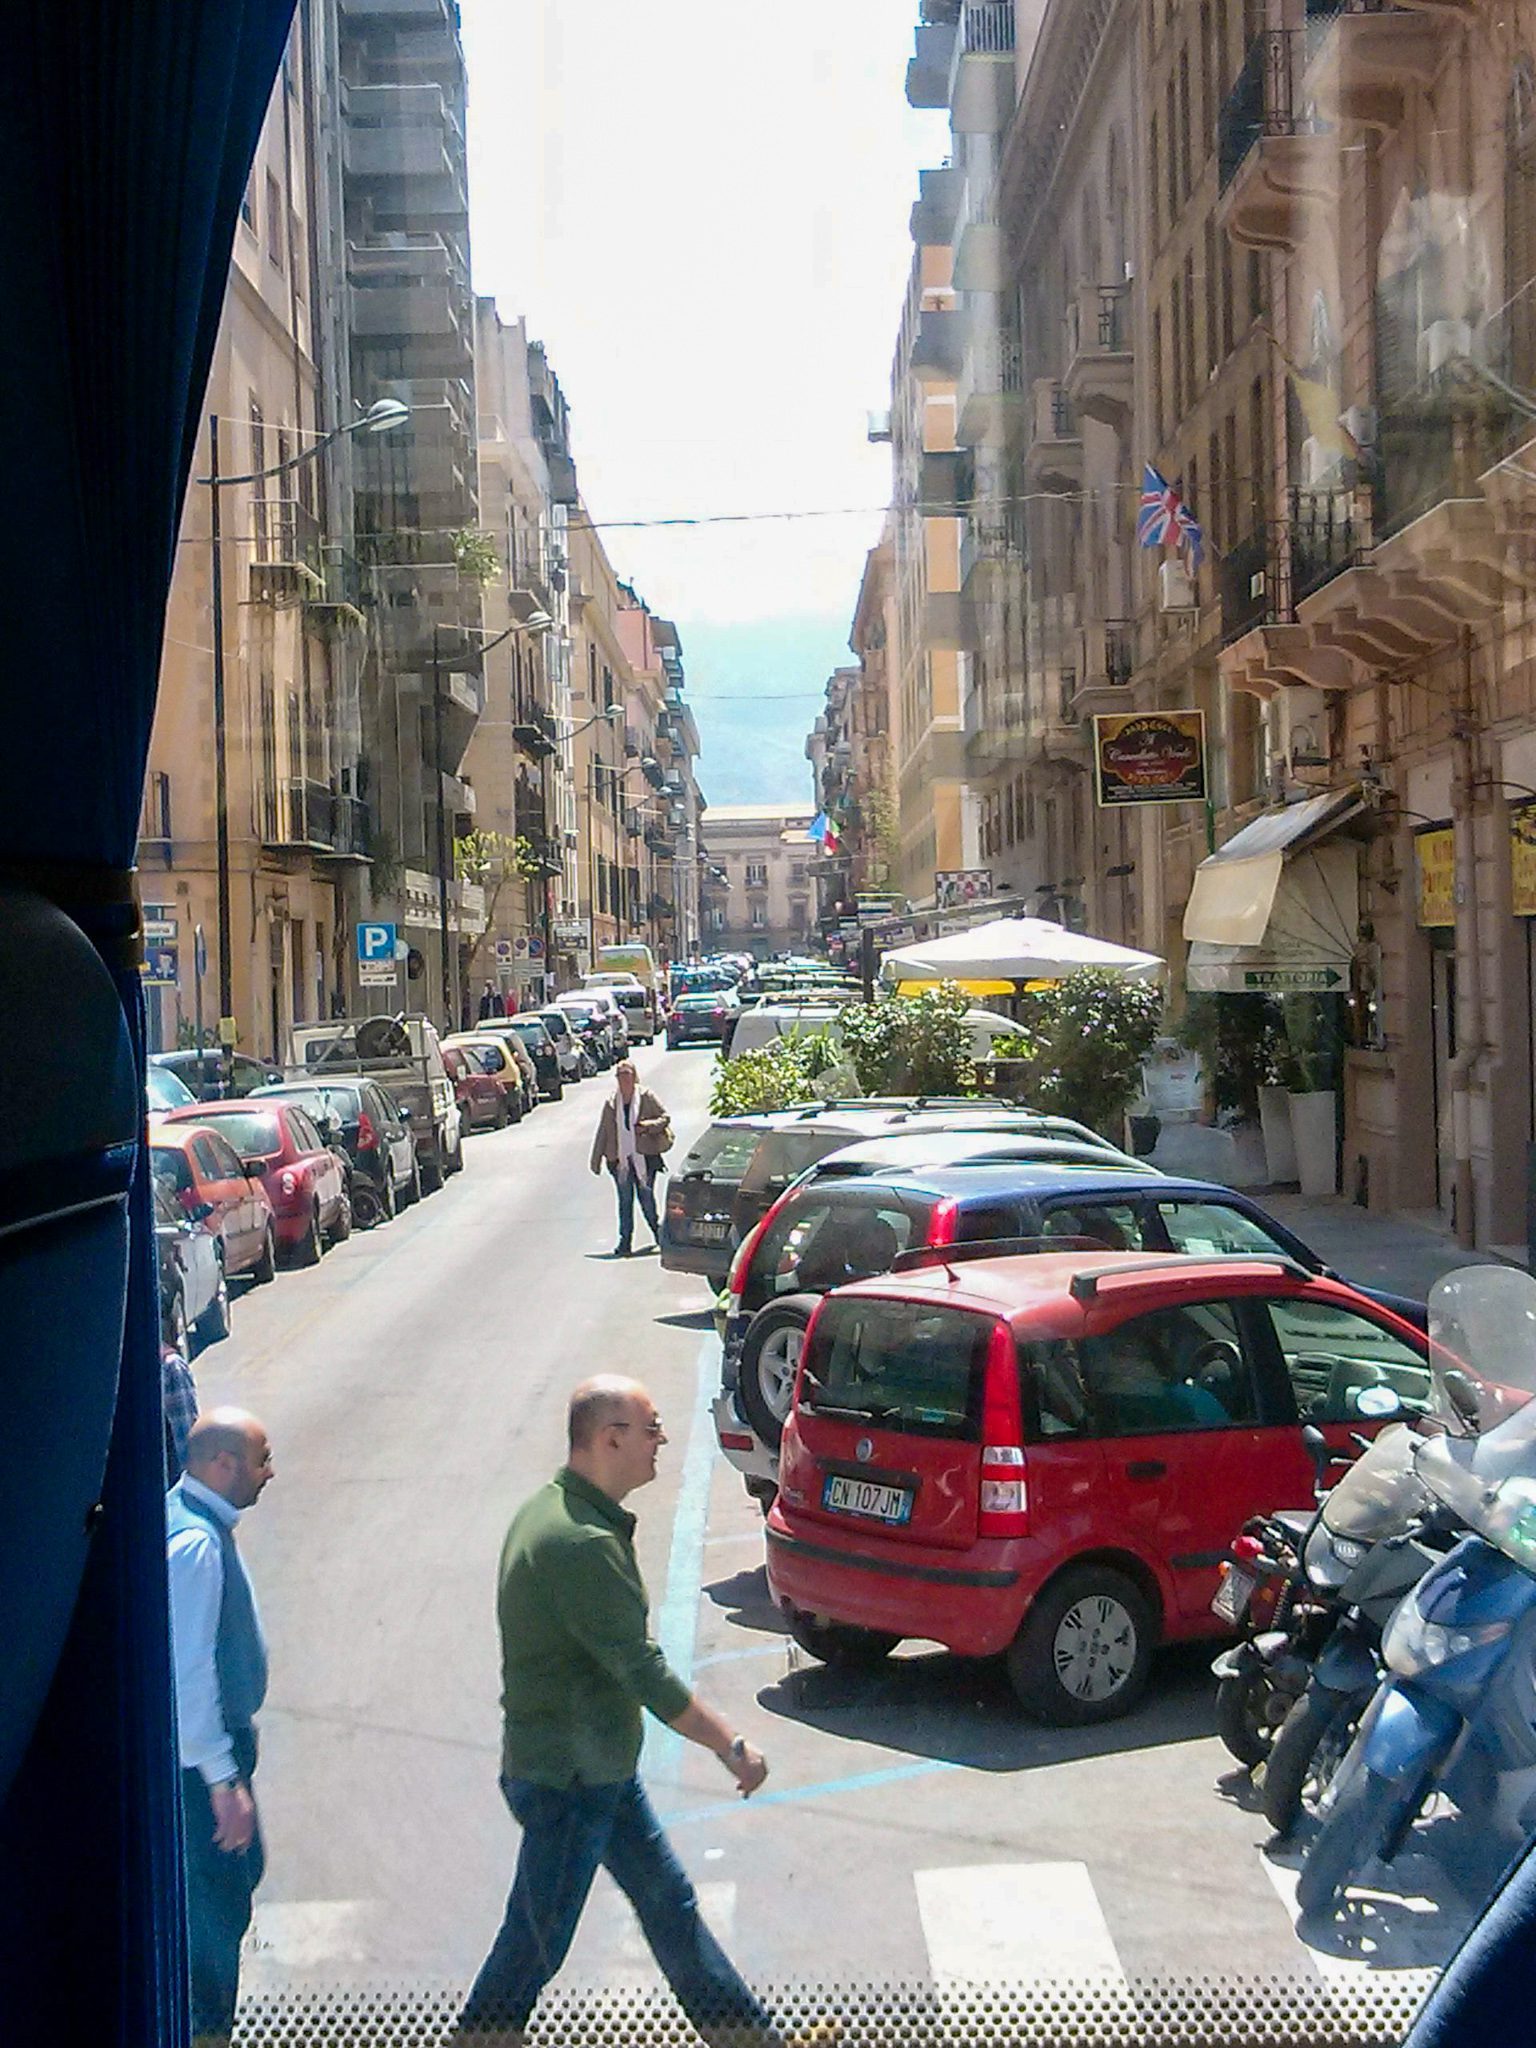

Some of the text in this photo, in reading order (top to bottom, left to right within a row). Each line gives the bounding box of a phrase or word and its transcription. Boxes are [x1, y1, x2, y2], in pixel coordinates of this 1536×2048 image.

[366, 928, 388, 957] P
[1255, 971, 1328, 984] TRATTORIA
[832, 1481, 850, 1505] CN
[854, 1484, 881, 1511] 107
[880, 1491, 901, 1516] JM
